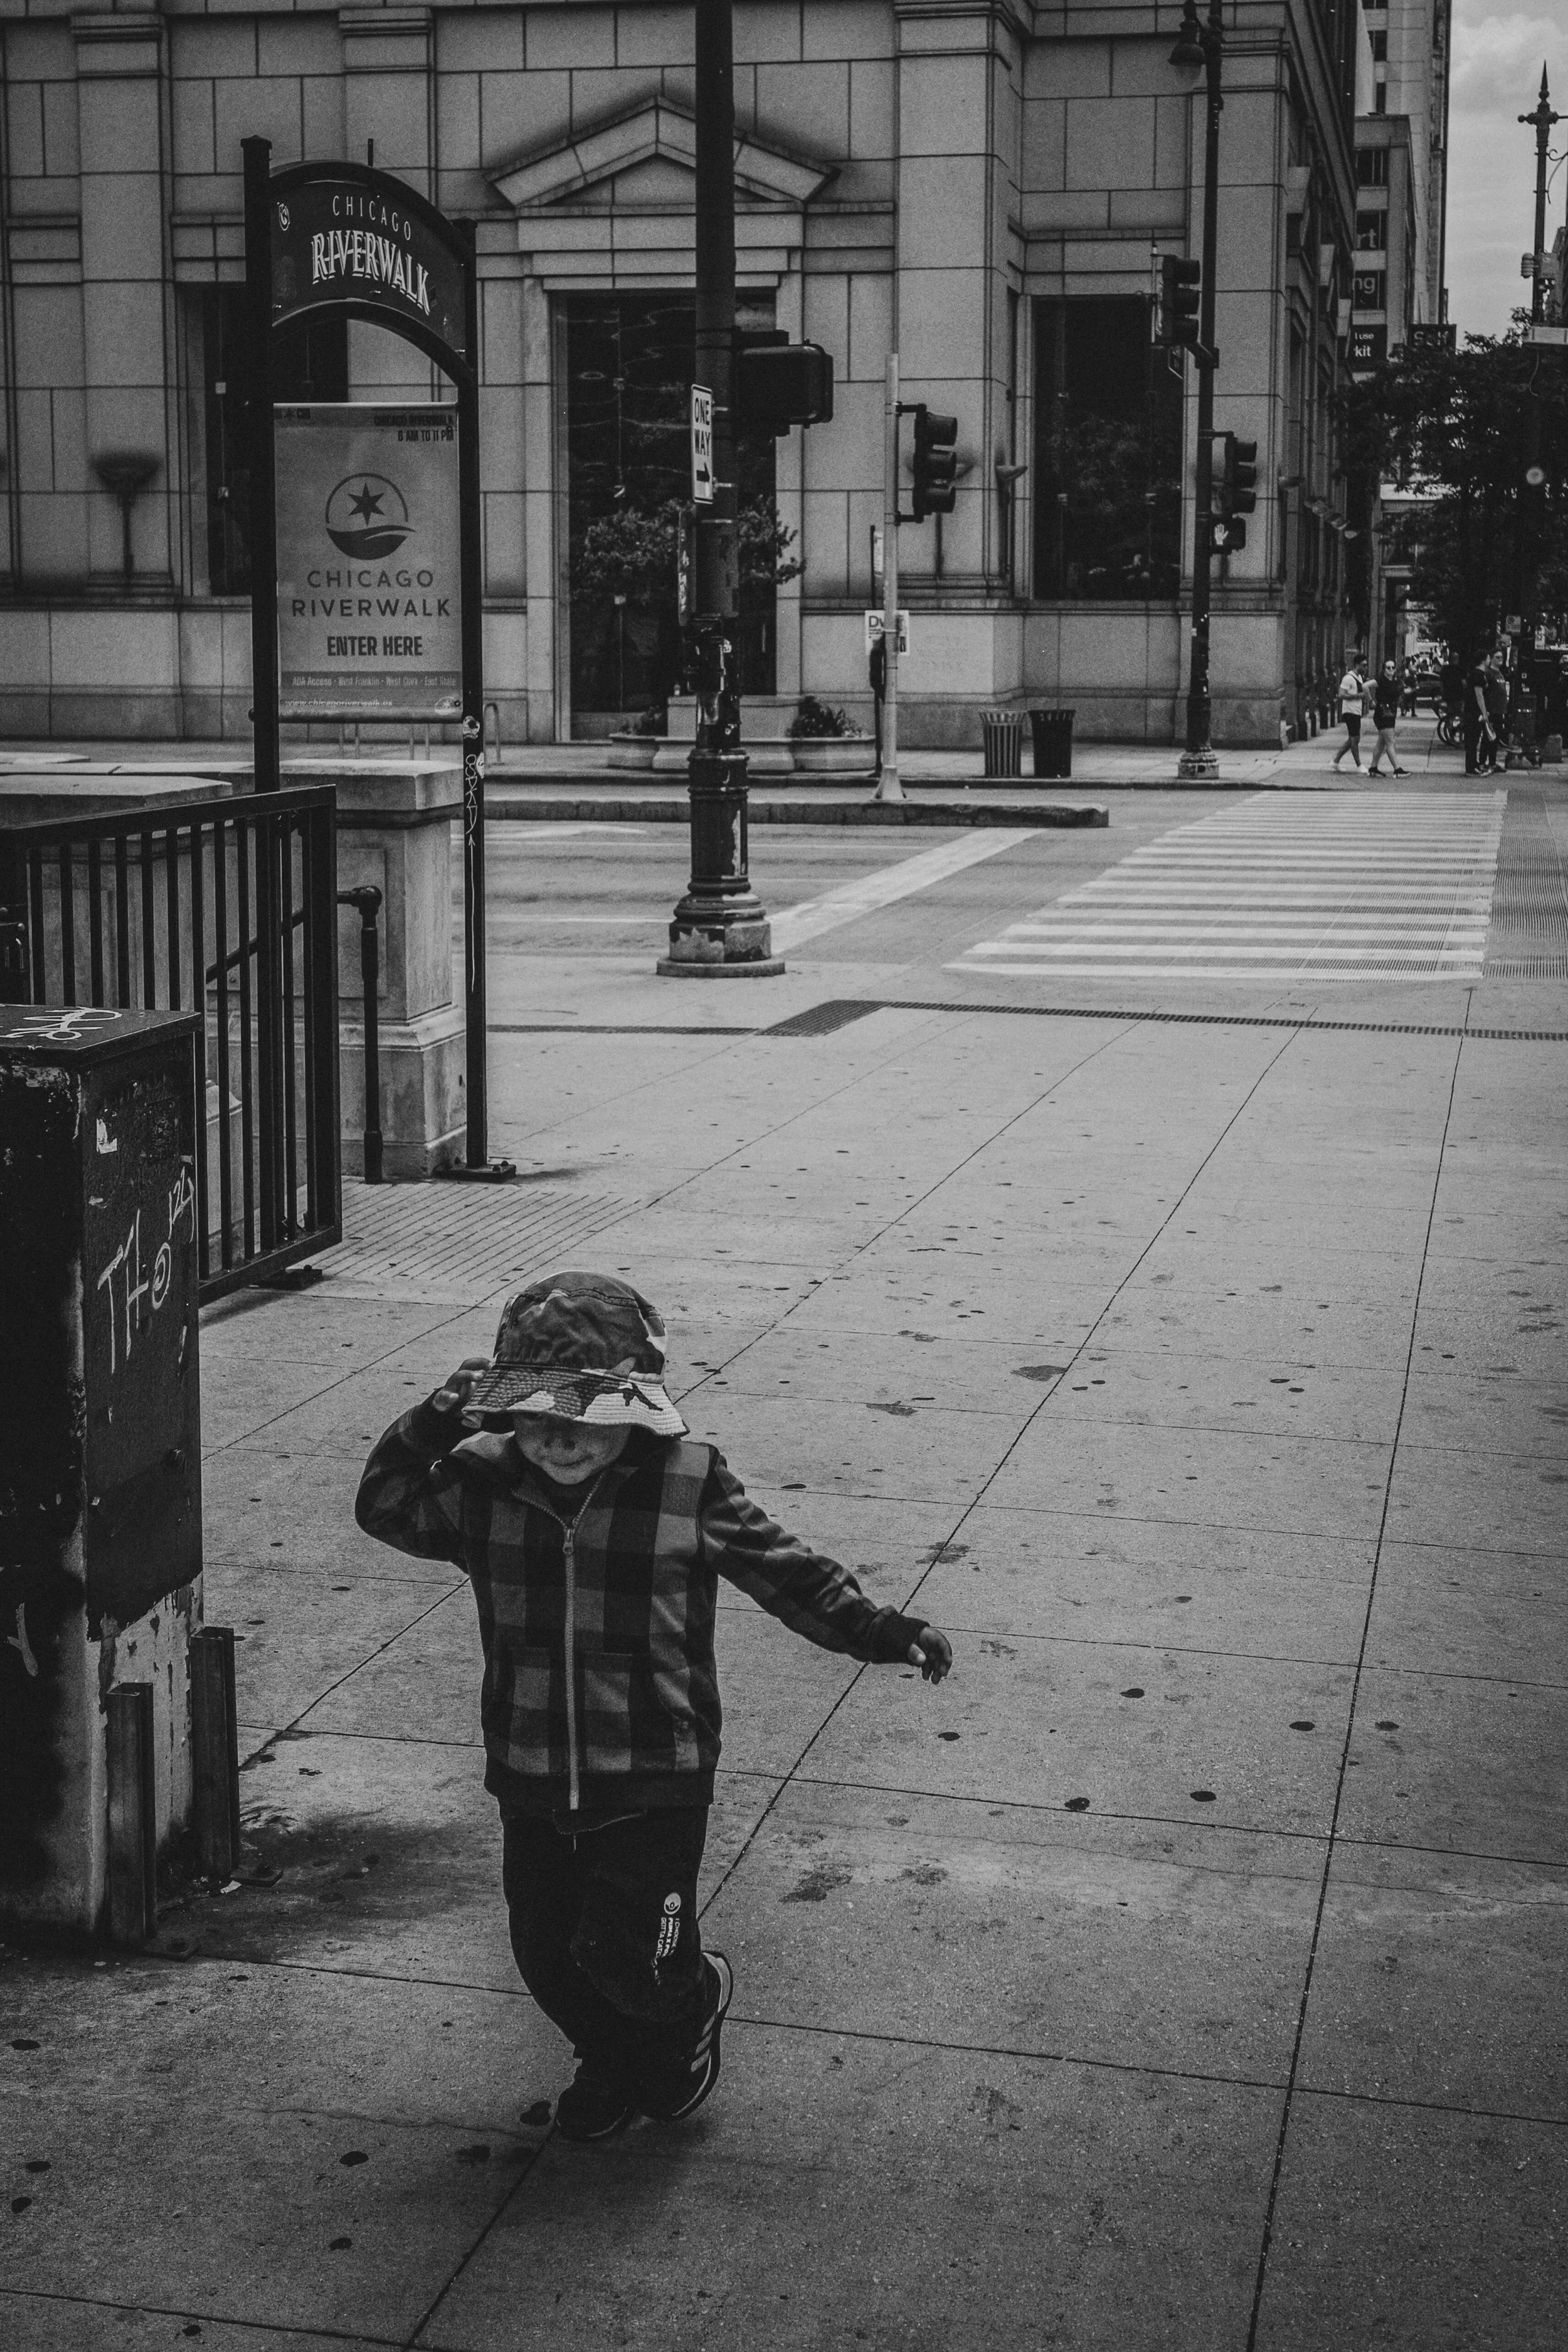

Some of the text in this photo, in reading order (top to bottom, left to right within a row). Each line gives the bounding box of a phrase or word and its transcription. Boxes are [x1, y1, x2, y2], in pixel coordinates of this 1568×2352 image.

[332, 195, 411, 241] CHICAGO
[311, 230, 430, 315] RIVERWALK
[374, 415, 406, 426] CHICAGO
[694, 397, 710, 425] ONE
[406, 430, 418, 442] AM
[694, 429, 711, 457] WAY
[307, 570, 433, 588] CHICAGO
[292, 599, 450, 617] RIVERWALK
[327, 636, 423, 656] ENTER HERE
[307, 677, 332, 686] Access
[355, 677, 379, 686] Franklin
